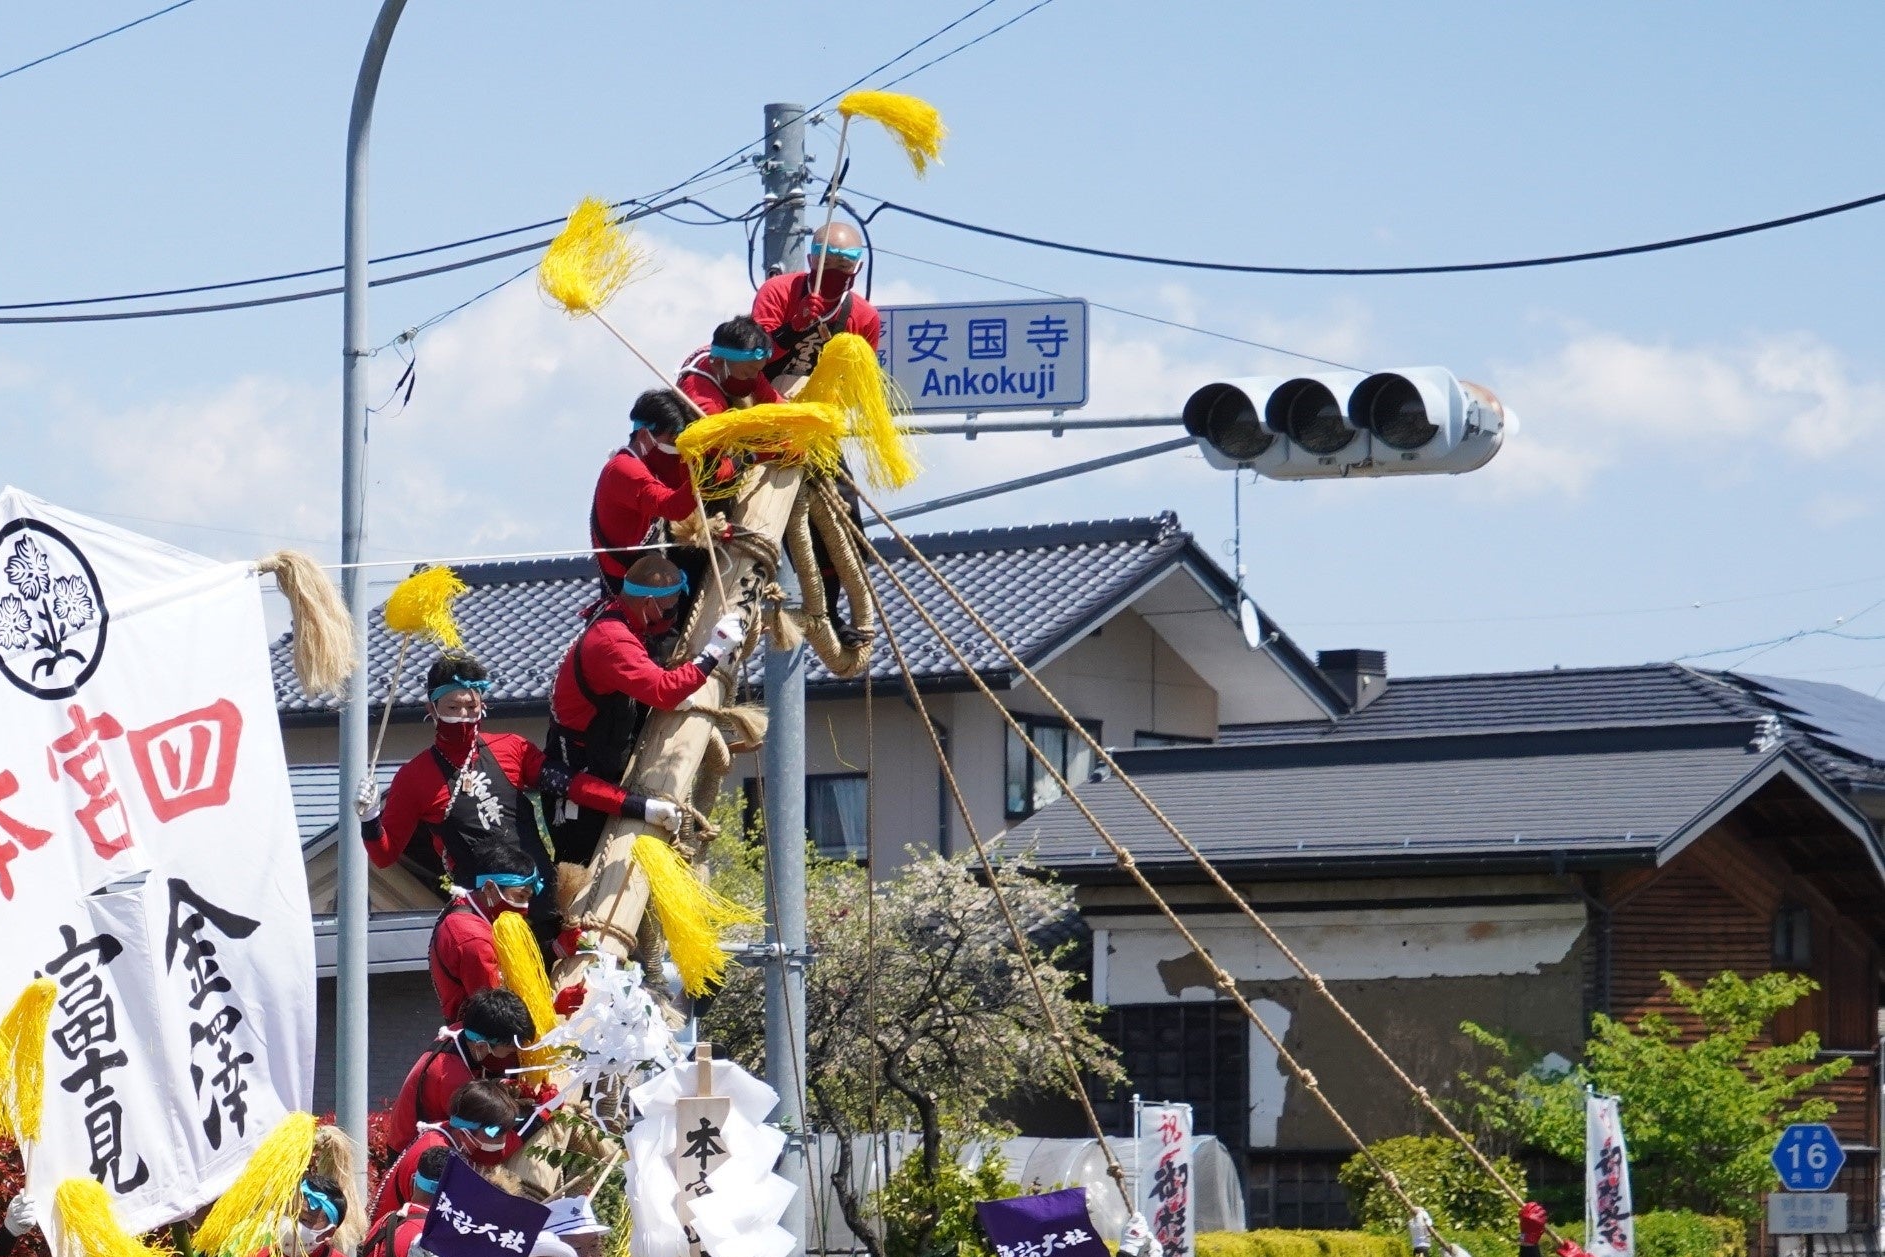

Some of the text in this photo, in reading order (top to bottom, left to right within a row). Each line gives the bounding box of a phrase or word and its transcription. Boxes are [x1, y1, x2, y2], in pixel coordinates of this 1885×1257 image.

[907, 315, 1069, 363] 安国寺
[921, 364, 1056, 399] Ankokuji
[166, 877, 261, 1150] 金澤
[35, 924, 149, 1195] 富士見
[1787, 1142, 1828, 1170] 16
[435, 1191, 526, 1254] 諏訪大社
